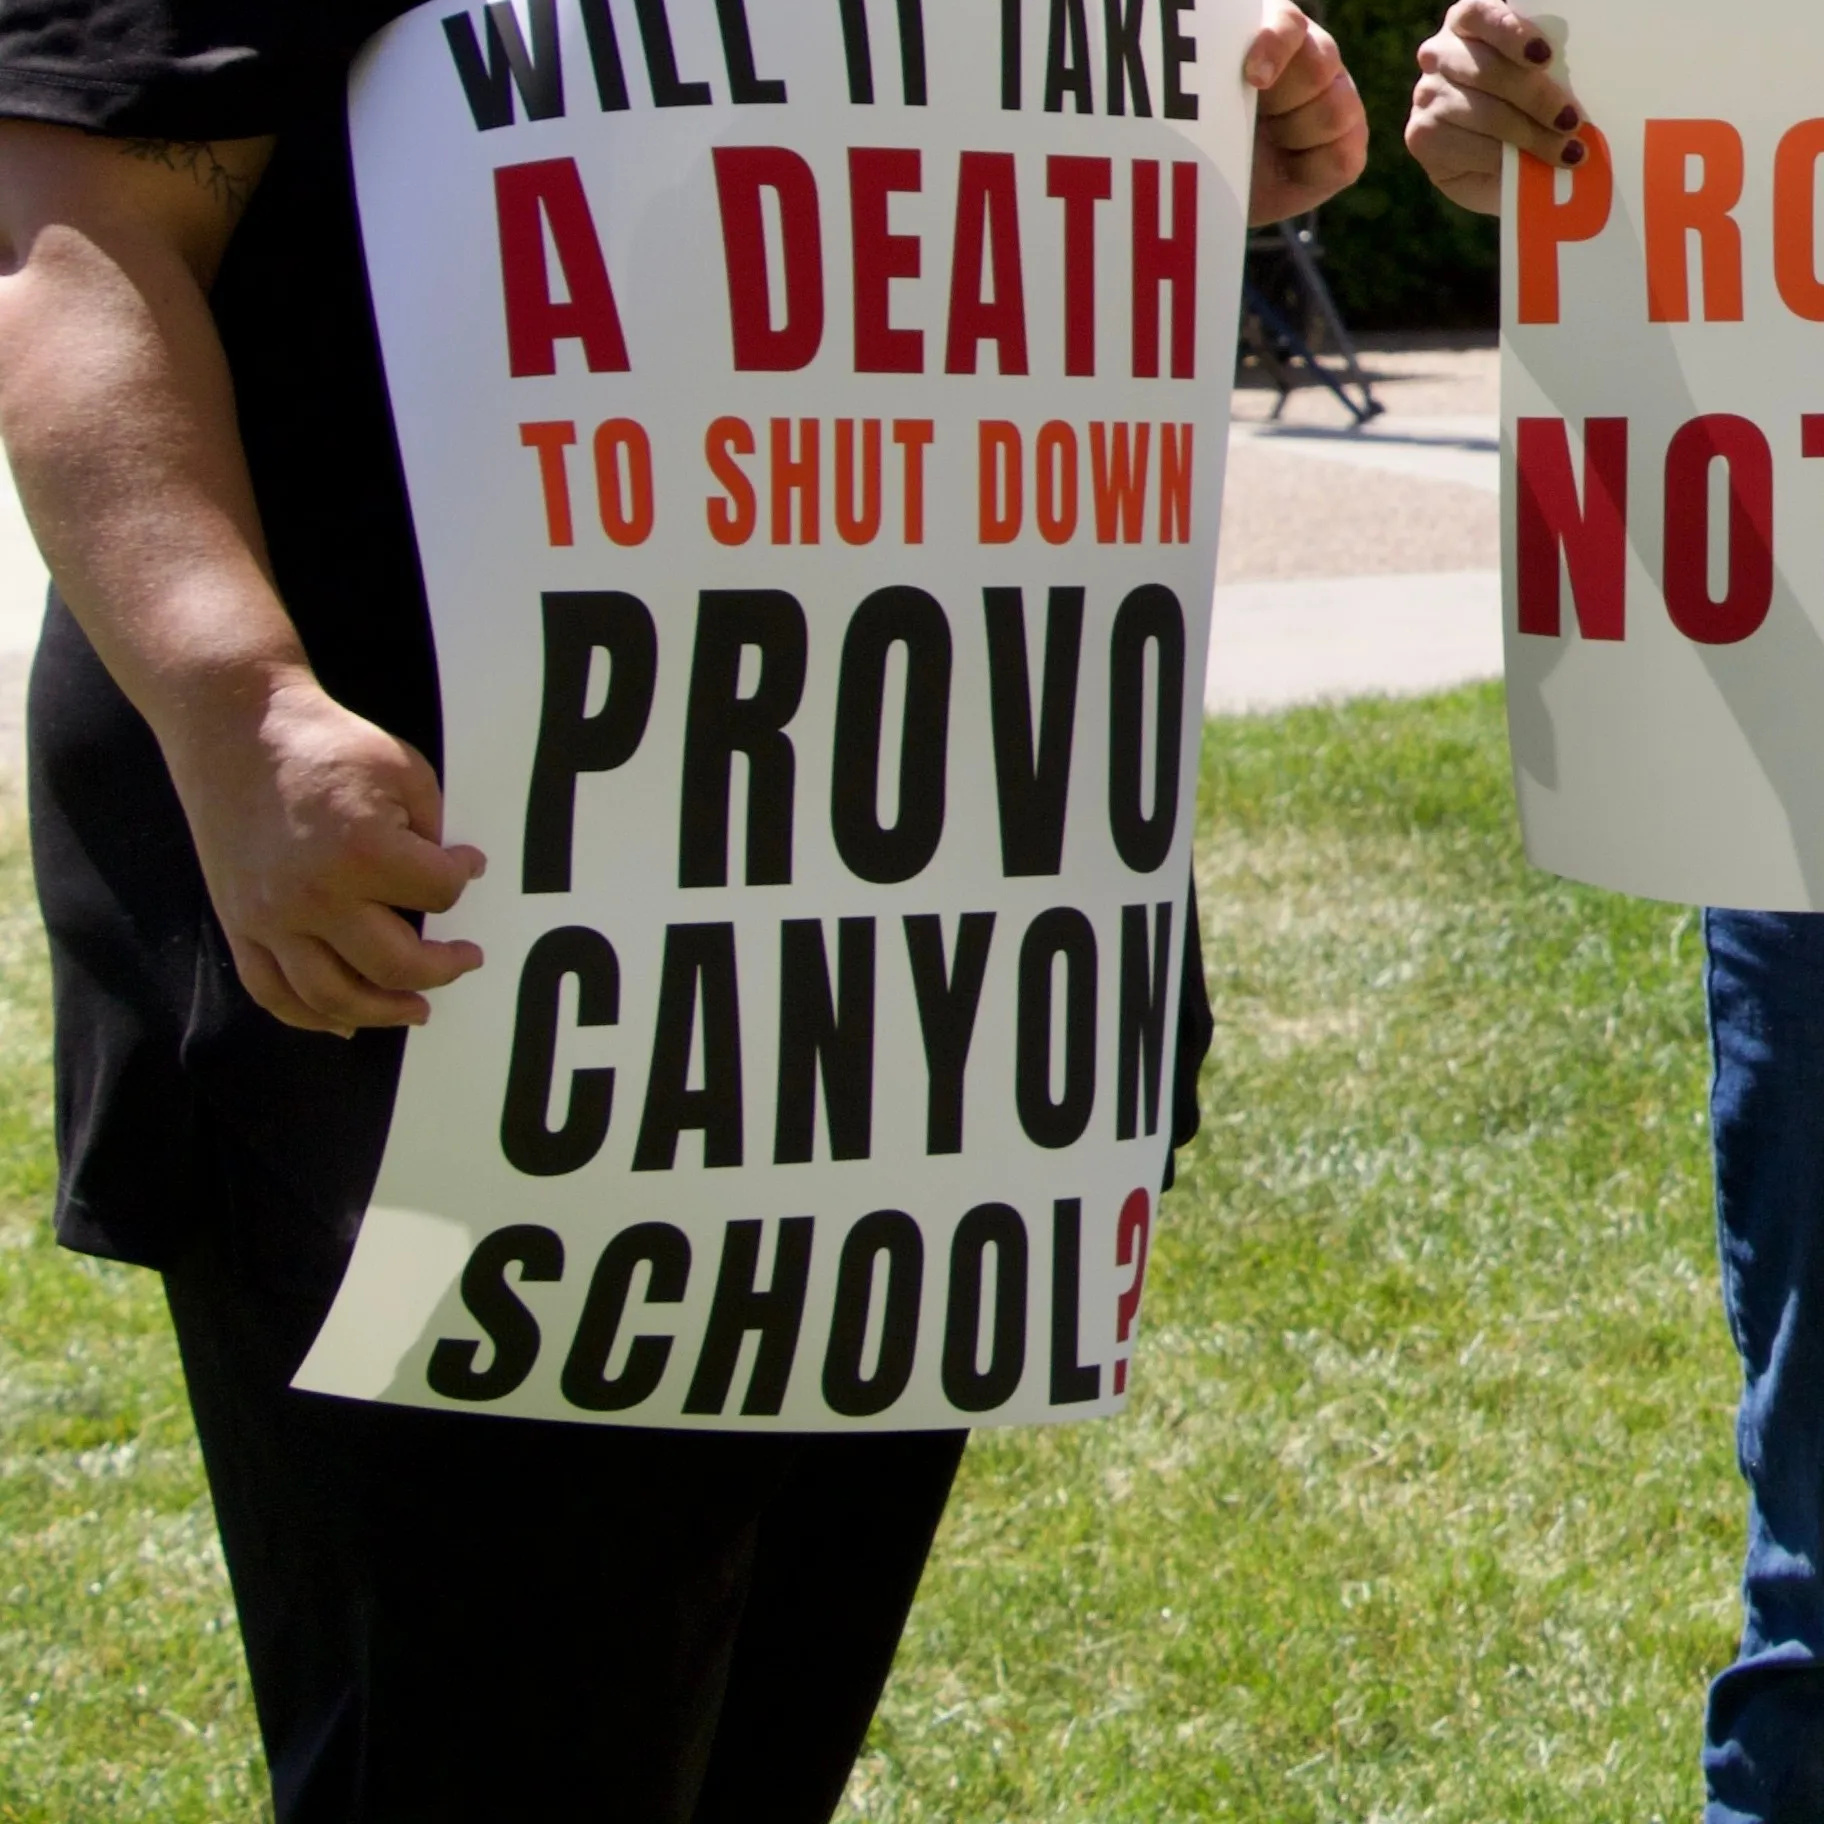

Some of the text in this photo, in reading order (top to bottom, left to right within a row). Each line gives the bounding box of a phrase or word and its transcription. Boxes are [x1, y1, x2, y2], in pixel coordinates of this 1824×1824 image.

[491, 146, 1198, 379] A DEATH
[520, 416, 1193, 547] TO SHUT DOWN
[521, 583, 1186, 895] PROVO
[500, 901, 1173, 1177] CANYON
[425, 1186, 1150, 1418] SCHOOL?
